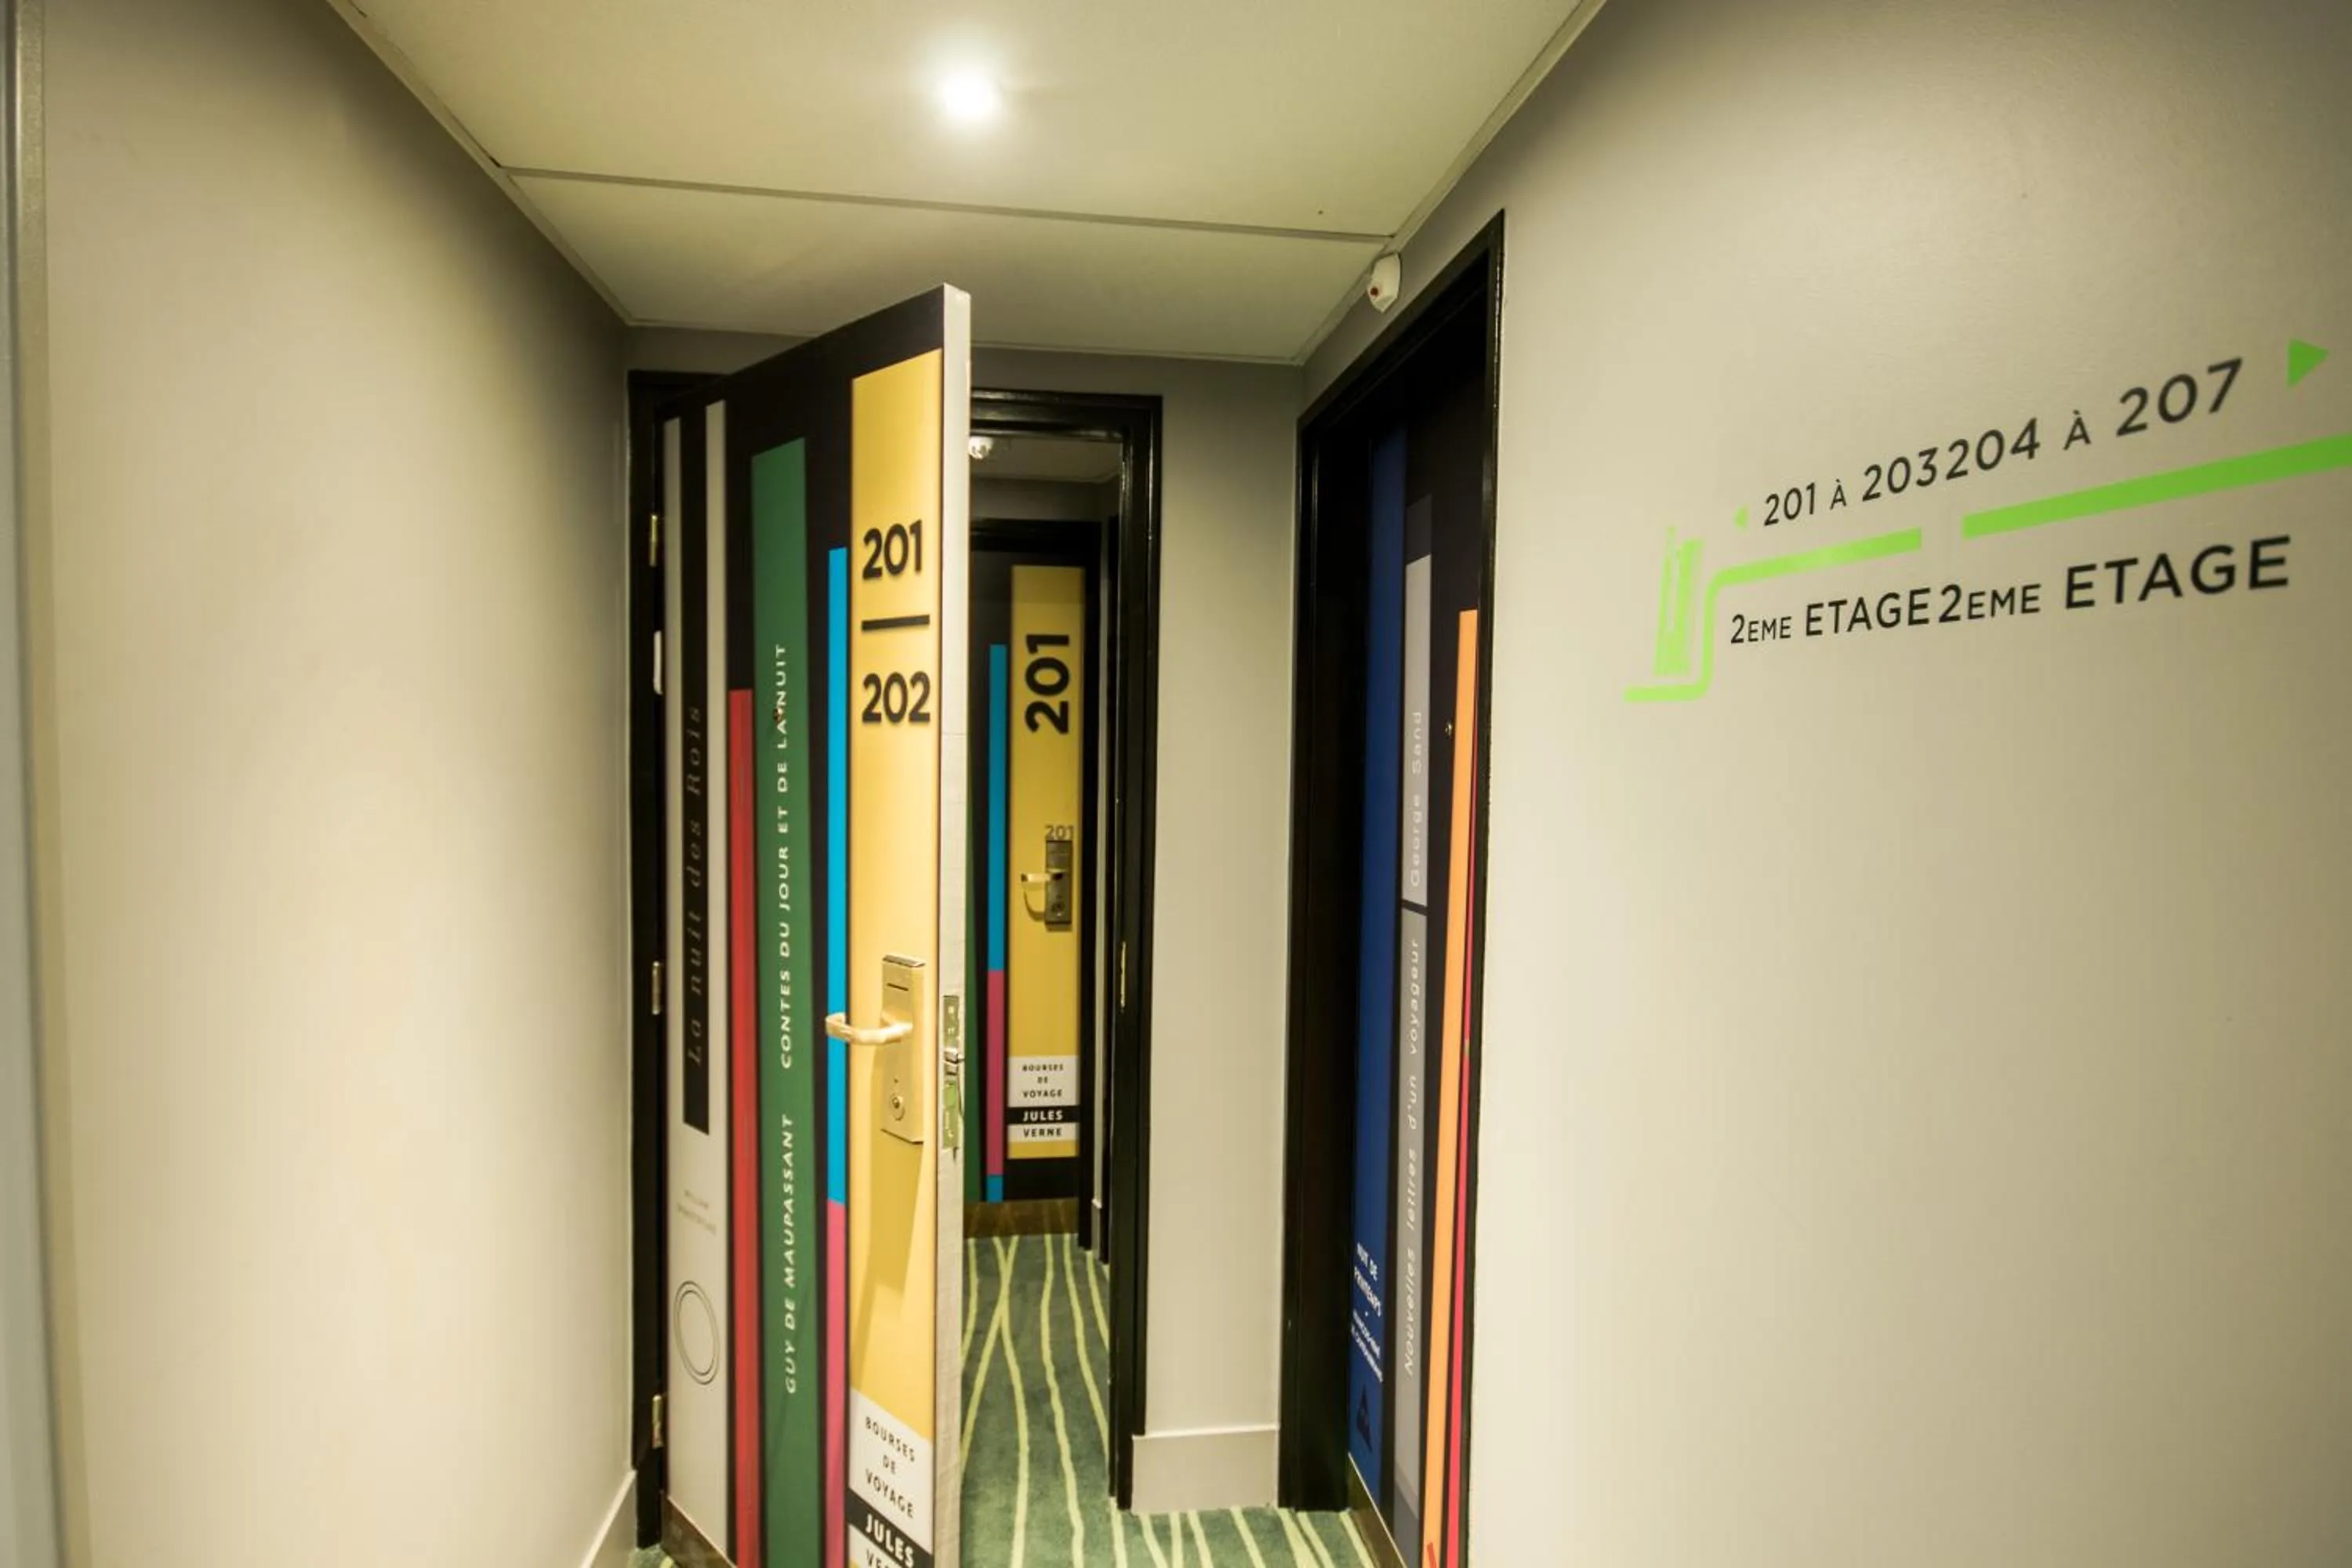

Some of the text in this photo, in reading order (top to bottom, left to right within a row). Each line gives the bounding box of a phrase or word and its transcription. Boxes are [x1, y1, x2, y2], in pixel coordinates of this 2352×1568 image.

[1945, 357, 2244, 481] 204 À 207
[1764, 448, 1938, 526] 201 À 203
[862, 519, 923, 579] 201
[1938, 535, 2292, 623] 2EME ETAGE
[1730, 587, 1932, 644] 2EME ETAGE
[862, 671, 931, 724] 202
[1025, 633, 1070, 735] 201
[1410, 711, 1422, 887] George Sand
[775, 644, 792, 1069] CONTES DU JOUR ET DE LA NUIT
[1044, 825, 1074, 840] 201
[686, 707, 702, 1066] La nuit des Rois
[1022, 1089, 1063, 1098] VOYAGE
[1022, 1110, 1063, 1122] JULES
[1023, 1127, 1062, 1138] VERNE
[1404, 938, 1421, 1376] Nouvelles lettres d'un voyageur
[782, 1114, 797, 1394] GUY DE MAUPASSANT
[865, 1416, 915, 1463] BOURSES
[882, 1455, 896, 1475] DE
[865, 1468, 914, 1519] VOYAGE
[865, 1513, 915, 1568] JULES
